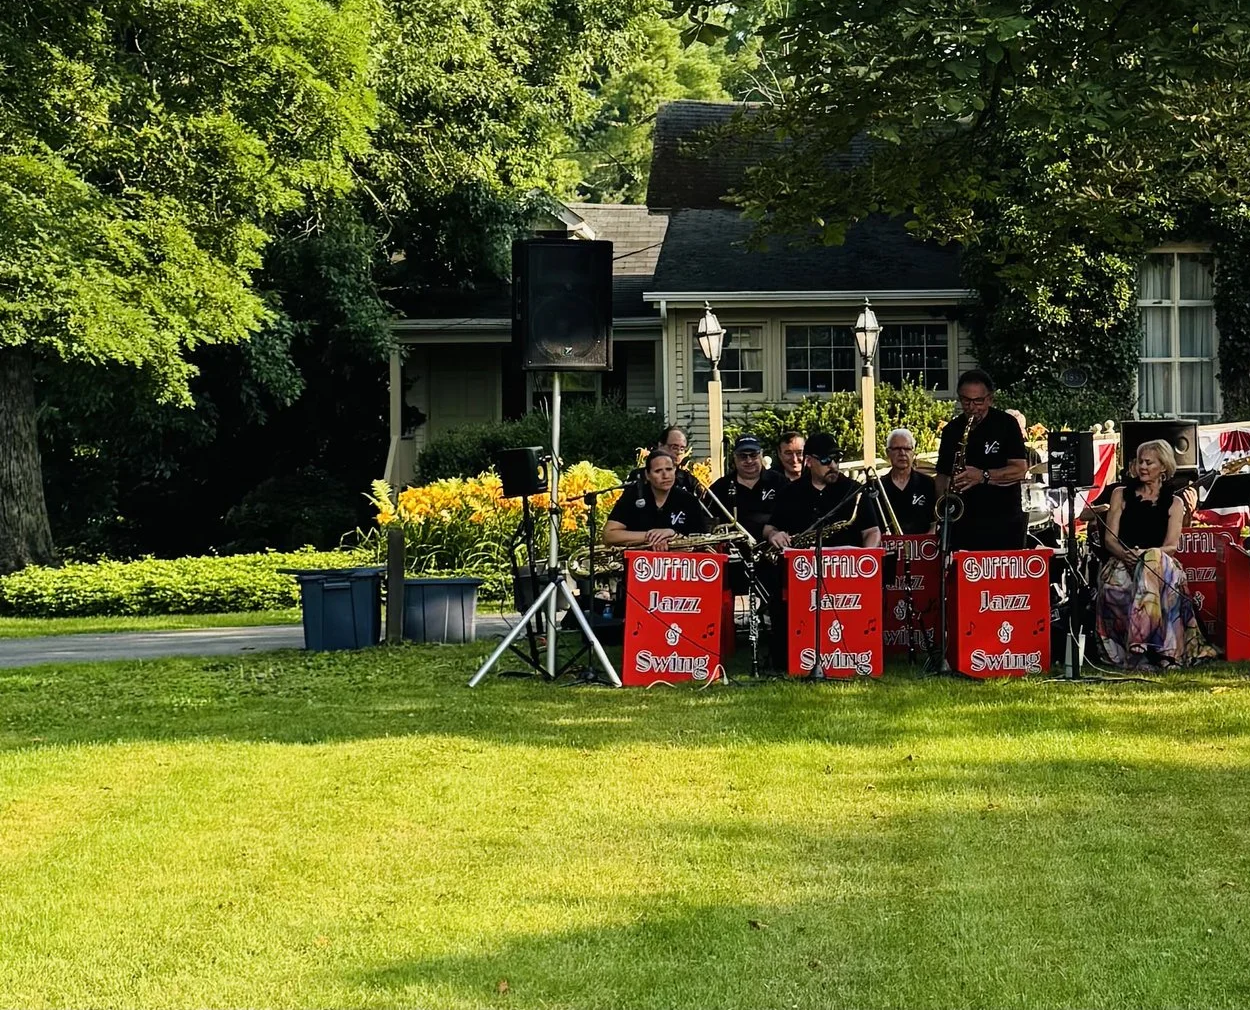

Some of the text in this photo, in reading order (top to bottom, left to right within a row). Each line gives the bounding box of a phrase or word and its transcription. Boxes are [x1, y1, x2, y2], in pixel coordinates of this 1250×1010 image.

[633, 556, 720, 582] BUFFALO
[963, 555, 1046, 582] BUFFALO
[1186, 567, 1217, 582] azz
[647, 591, 701, 613] Jazz
[809, 588, 862, 612] Jazz
[979, 590, 1031, 613] Jazz
[665, 623, 682, 646] &
[828, 619, 844, 643] &
[997, 621, 1013, 643] &
[636, 650, 709, 680] Swing
[800, 648, 872, 676] Swing
[971, 649, 1042, 673] Swing
